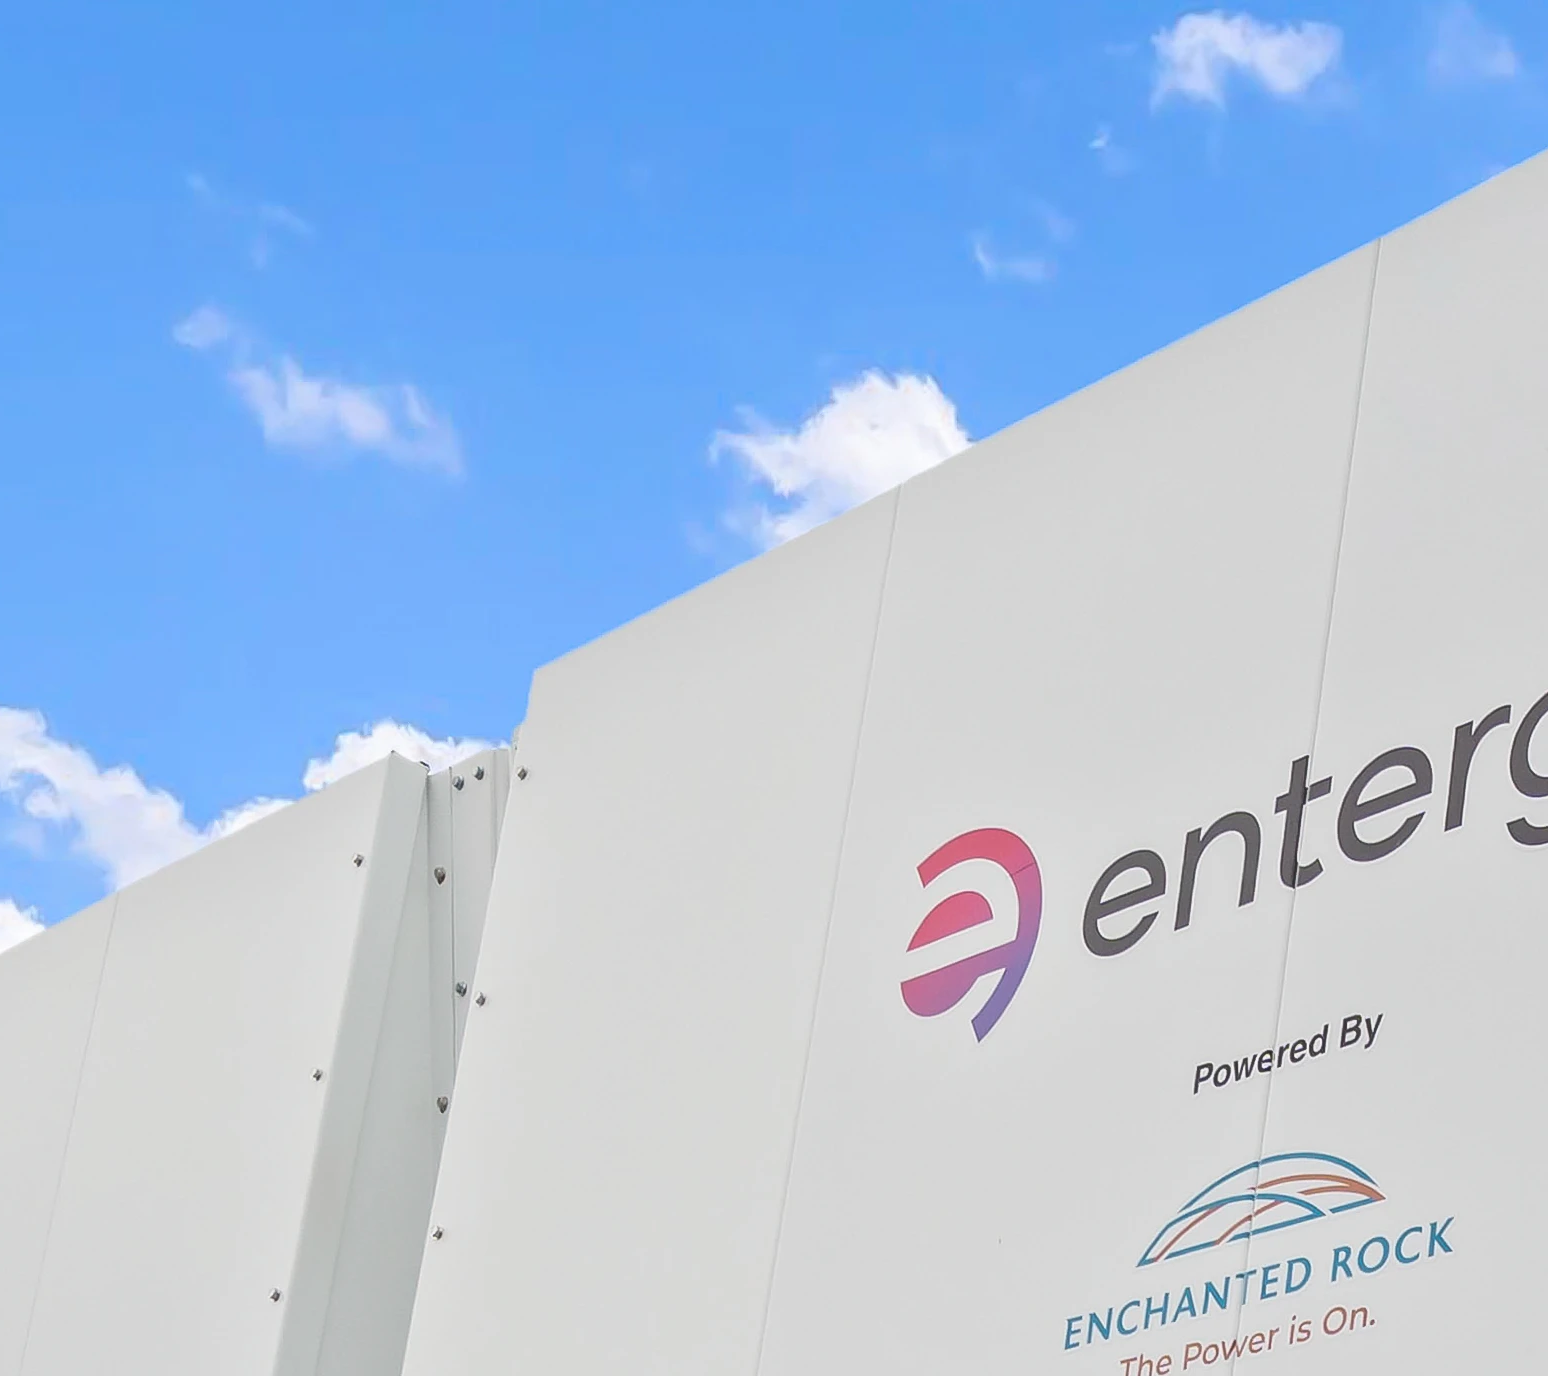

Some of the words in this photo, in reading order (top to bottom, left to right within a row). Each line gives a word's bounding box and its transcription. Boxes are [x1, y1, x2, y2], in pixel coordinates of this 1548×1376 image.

[1192, 1024, 1329, 1095] Powered
[1339, 1013, 1384, 1050] By
[1063, 1256, 1312, 1350] ENCHANTED
[1329, 1215, 1455, 1283] ROCK
[1182, 1326, 1280, 1371] Power
[1288, 1314, 1312, 1345] is
[1322, 1304, 1376, 1336] On.
